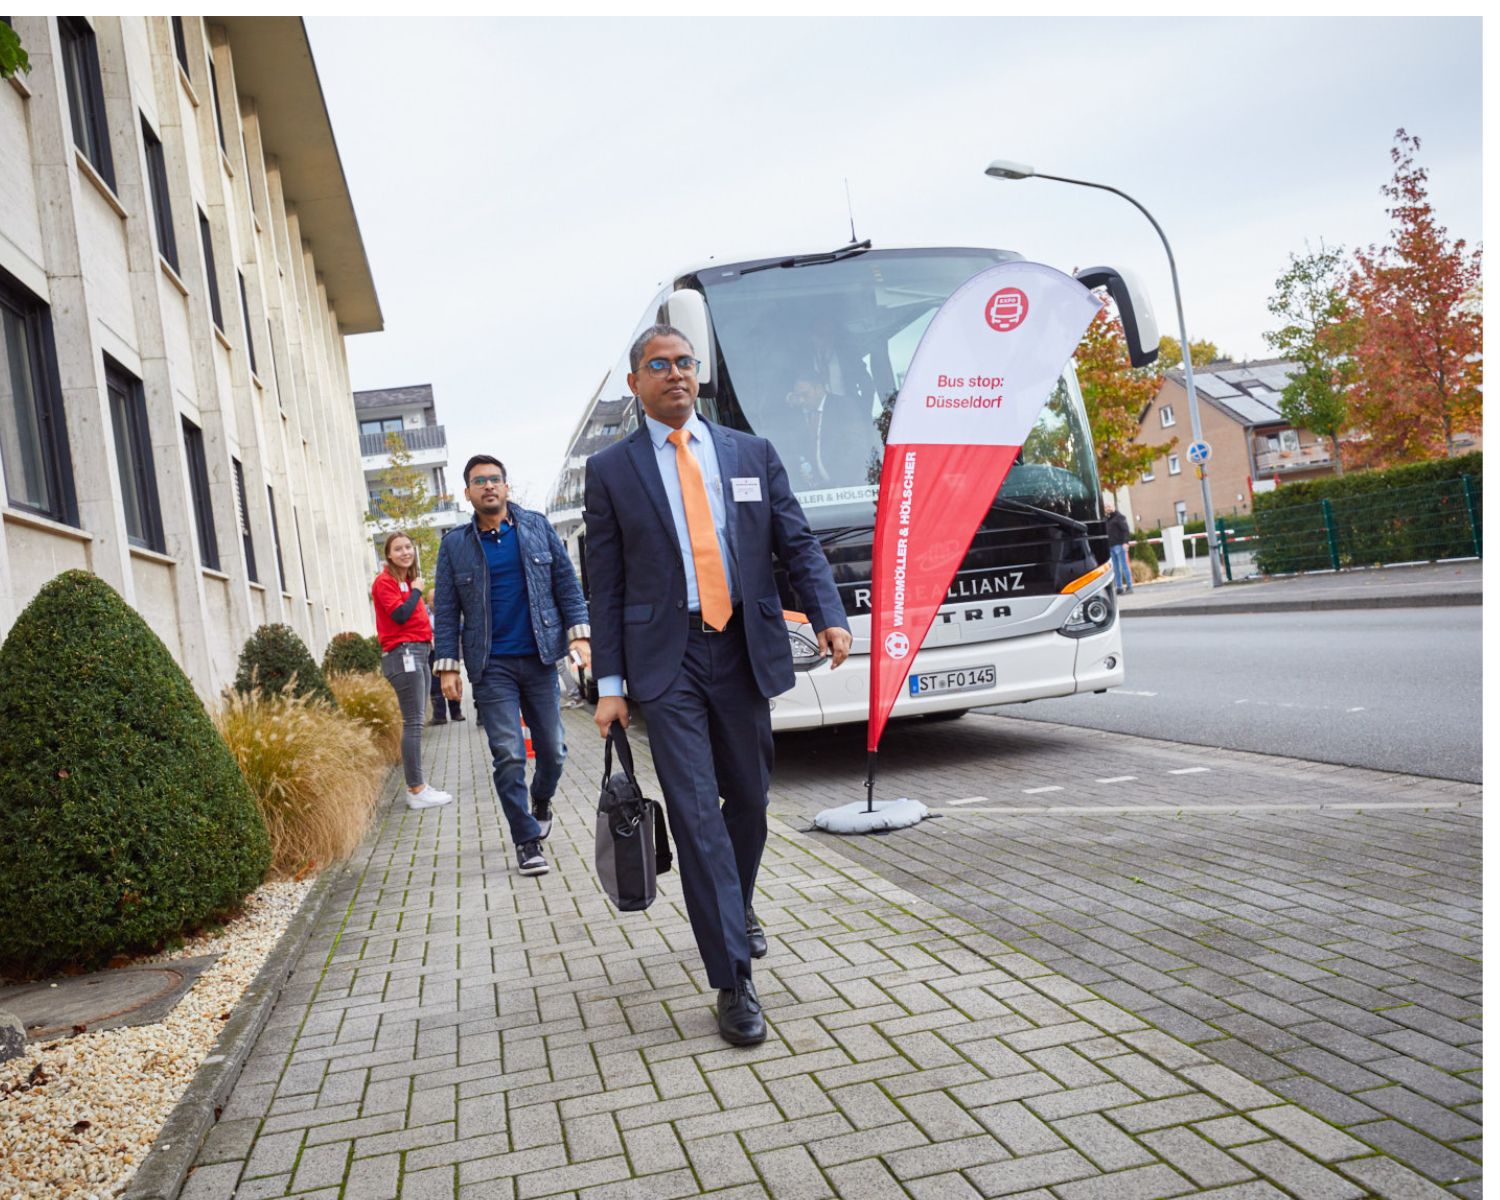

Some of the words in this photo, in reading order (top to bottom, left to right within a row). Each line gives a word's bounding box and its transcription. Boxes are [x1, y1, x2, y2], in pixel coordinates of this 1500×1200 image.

[937, 375, 964, 387] Bus
[968, 376, 1004, 389] stop:
[925, 395, 1003, 408] Düsseldorf
[836, 488, 879, 500] HÖLSCH
[899, 451, 917, 525] HÖLSCHER
[899, 527, 909, 537] &
[893, 538, 908, 627] WINDMÖLLER
[969, 670, 994, 685] 145
